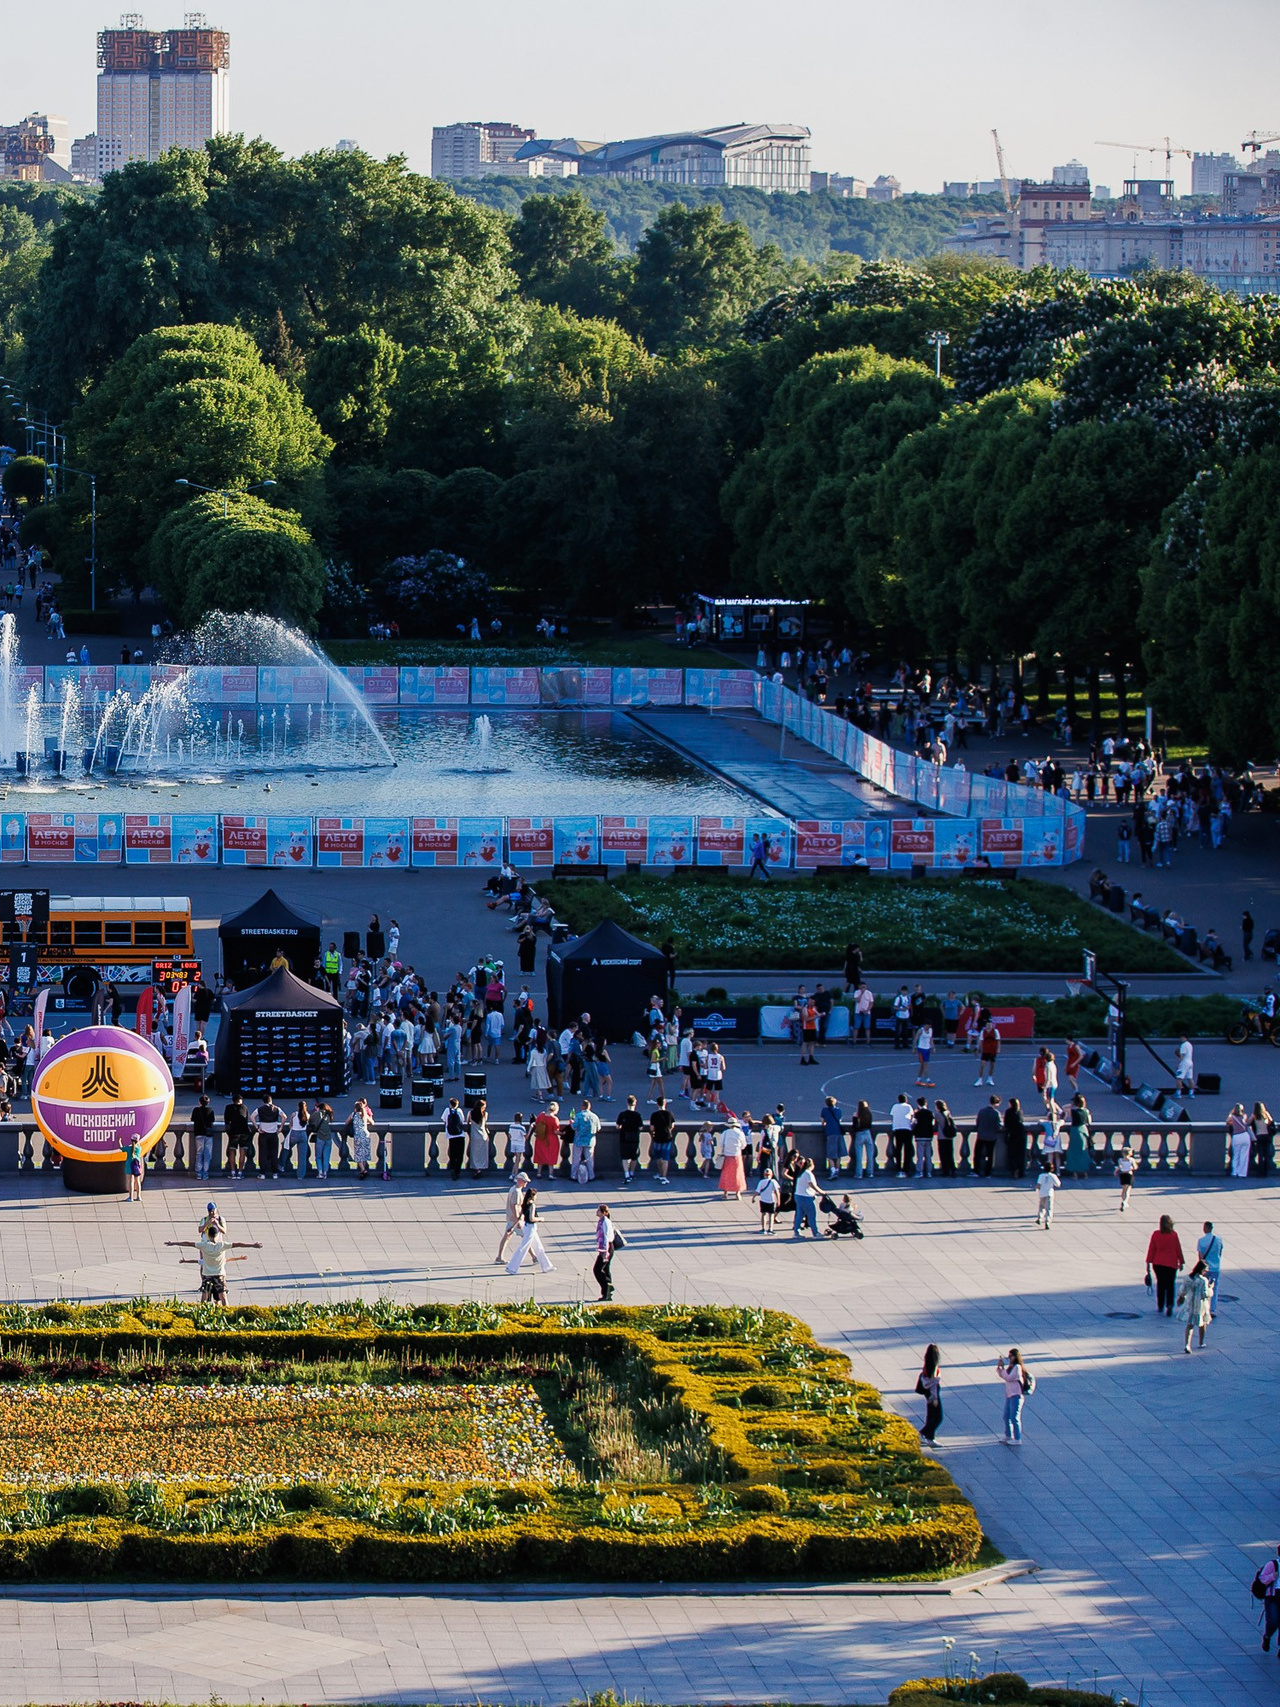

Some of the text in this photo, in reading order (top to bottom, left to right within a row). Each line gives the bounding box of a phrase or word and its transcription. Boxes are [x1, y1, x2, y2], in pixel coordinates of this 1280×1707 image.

[35, 831, 68, 839] ЛЕТО
[132, 830, 164, 838] ЛЕТО
[228, 831, 260, 840] ЛЕТО
[325, 833, 357, 842] ЛЕТО
[419, 832, 451, 842] ЛЕТО
[515, 832, 547, 842] ЛЕТО
[704, 832, 737, 841] ЛЕТО
[988, 834, 1017, 842] ЛЕТО
[803, 838, 836, 846] ЛЕТО
[21, 952, 26, 962] 1
[159, 971, 166, 981] 3
[194, 971, 201, 981] 2
[169, 1037, 173, 1045] 3
[66, 1110, 136, 1127] МОСКОВСКИЙ
[84, 1129, 116, 1142] СПОРТ
